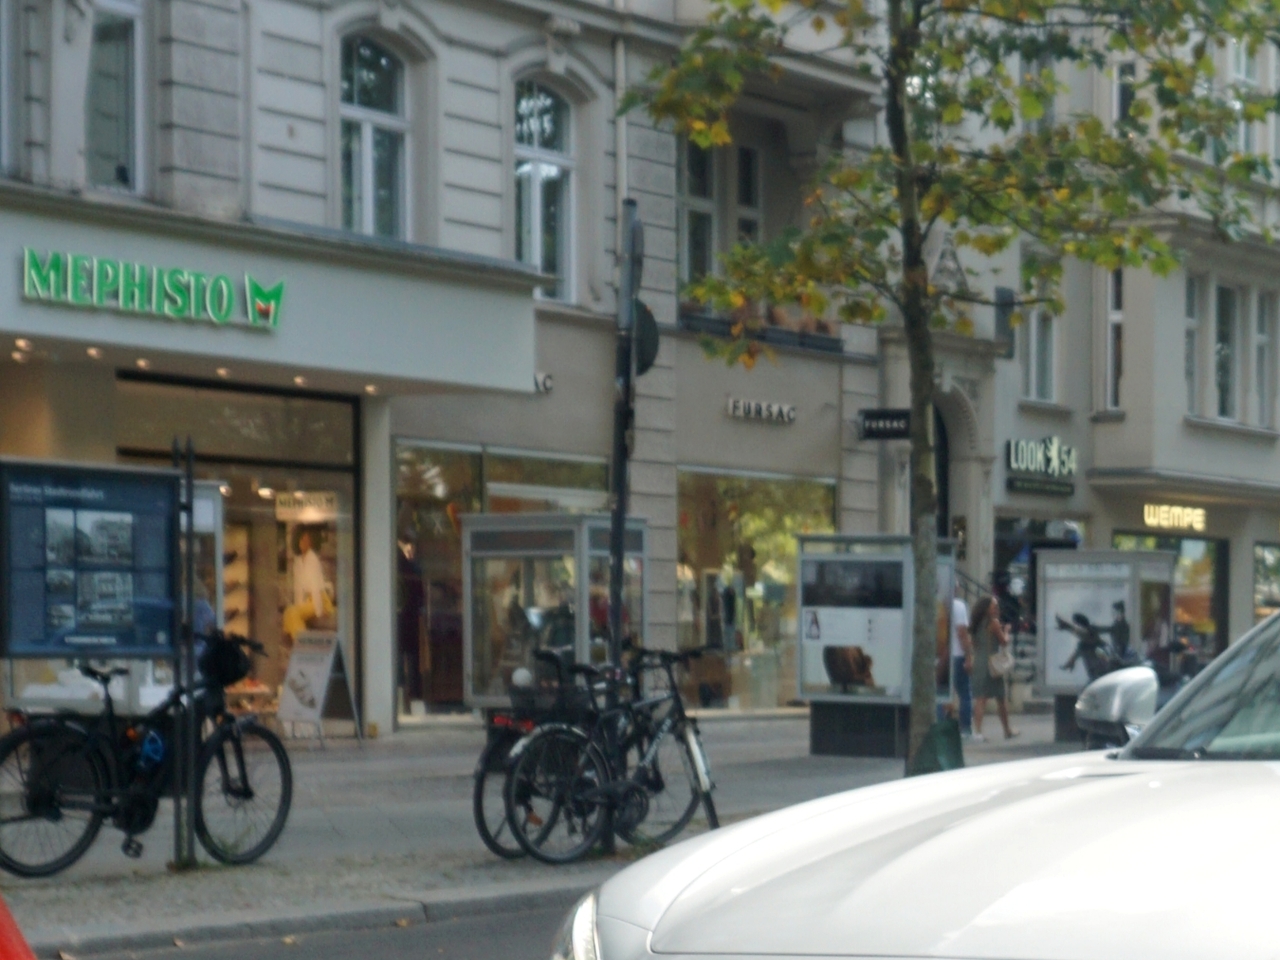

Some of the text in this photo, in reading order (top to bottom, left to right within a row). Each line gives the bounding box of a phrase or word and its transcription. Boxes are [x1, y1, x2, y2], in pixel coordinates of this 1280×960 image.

[24, 246, 235, 325] MEPHISTO
[729, 398, 798, 423] FURSAC
[1010, 438, 1077, 476] LOOK 54
[1144, 503, 1207, 532] WEMPE
